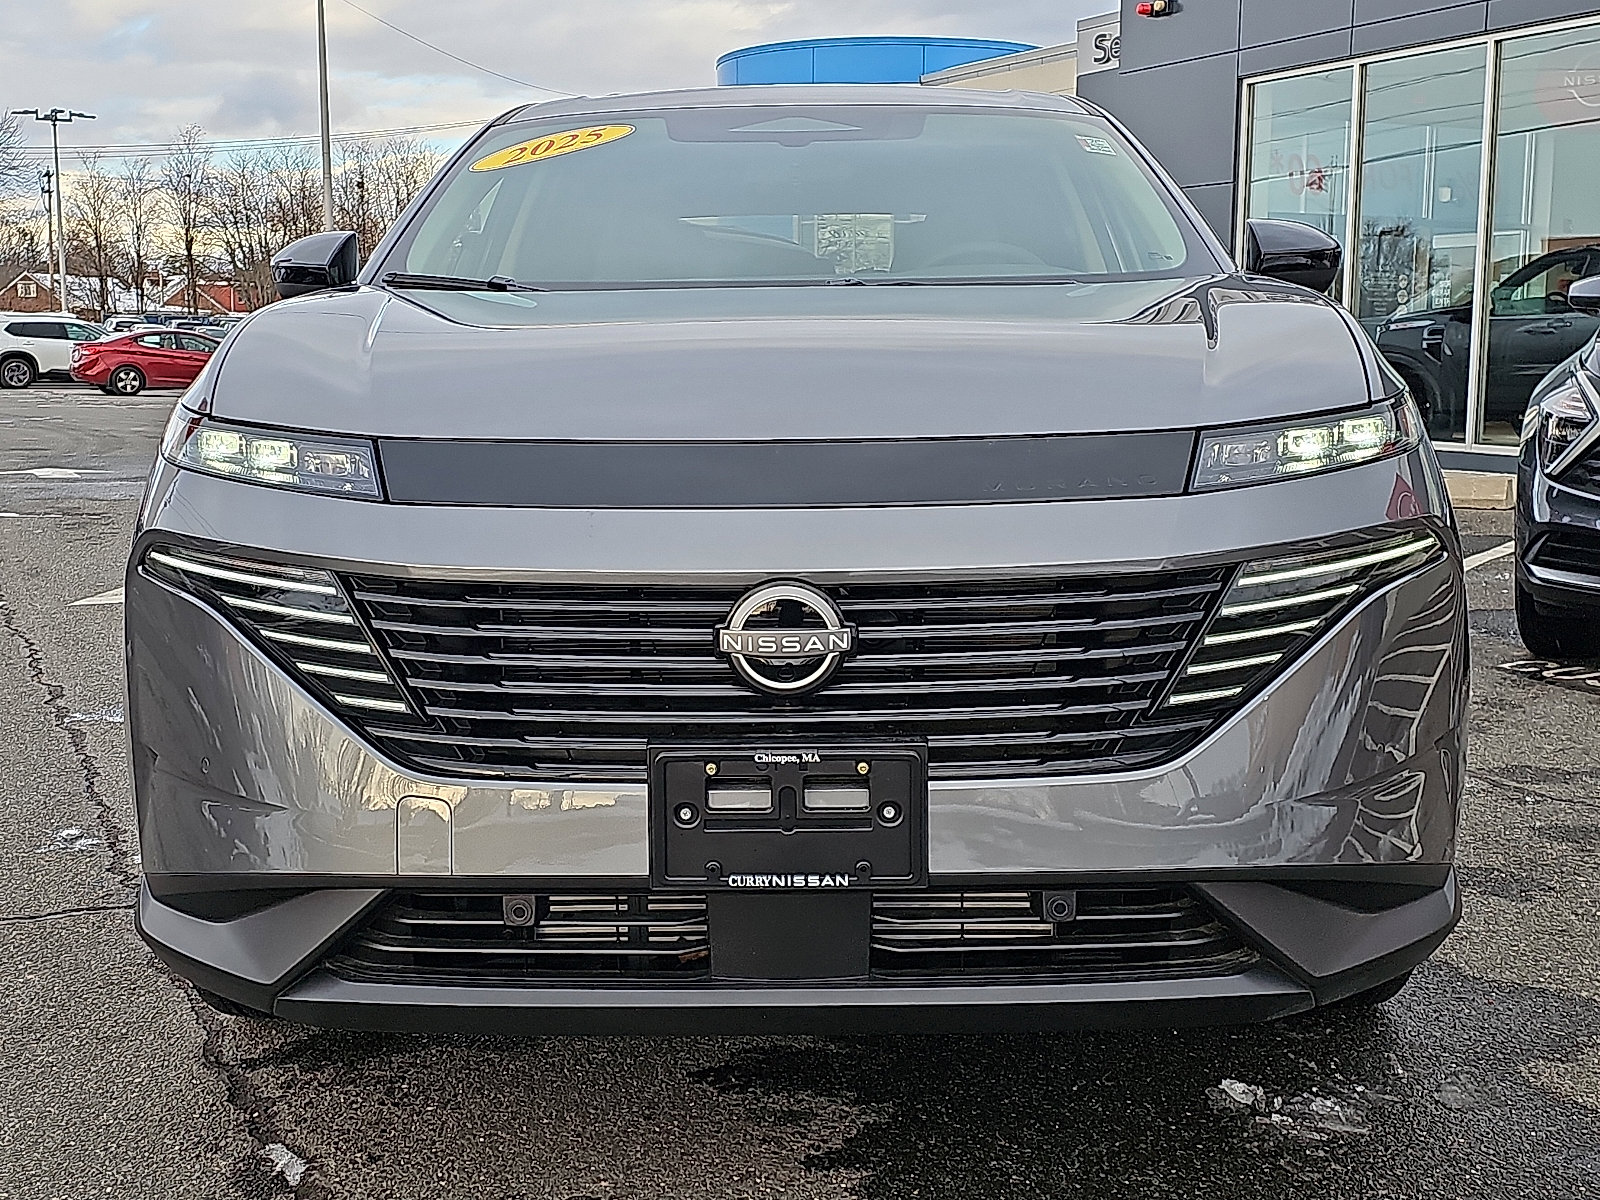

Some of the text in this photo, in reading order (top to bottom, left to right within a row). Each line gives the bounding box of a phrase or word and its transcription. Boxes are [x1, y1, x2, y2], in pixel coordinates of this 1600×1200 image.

[1564, 75, 1600, 87] NIS
[502, 127, 608, 166] 2025
[722, 632, 849, 653] NISSAN
[754, 753, 821, 765] Chicopee, MA
